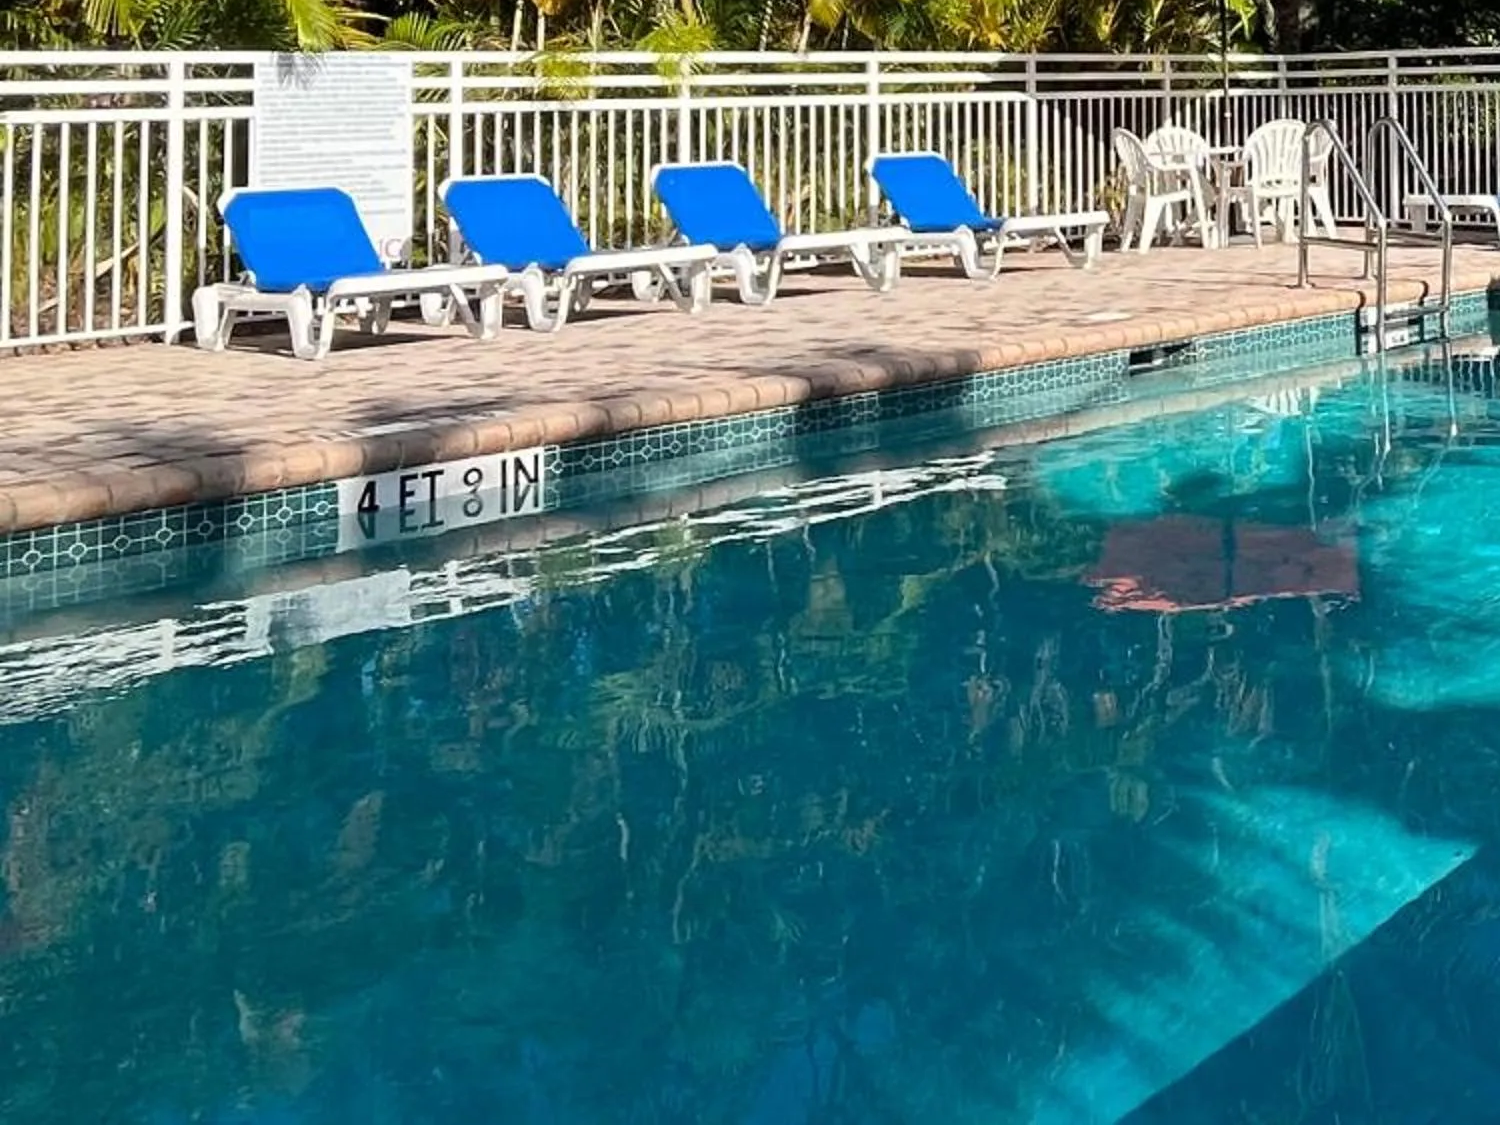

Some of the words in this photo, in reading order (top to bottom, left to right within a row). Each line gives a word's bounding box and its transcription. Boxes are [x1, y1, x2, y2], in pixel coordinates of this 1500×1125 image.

[356, 480, 381, 513] 4
[399, 469, 446, 508] FT
[501, 453, 540, 489] IN
